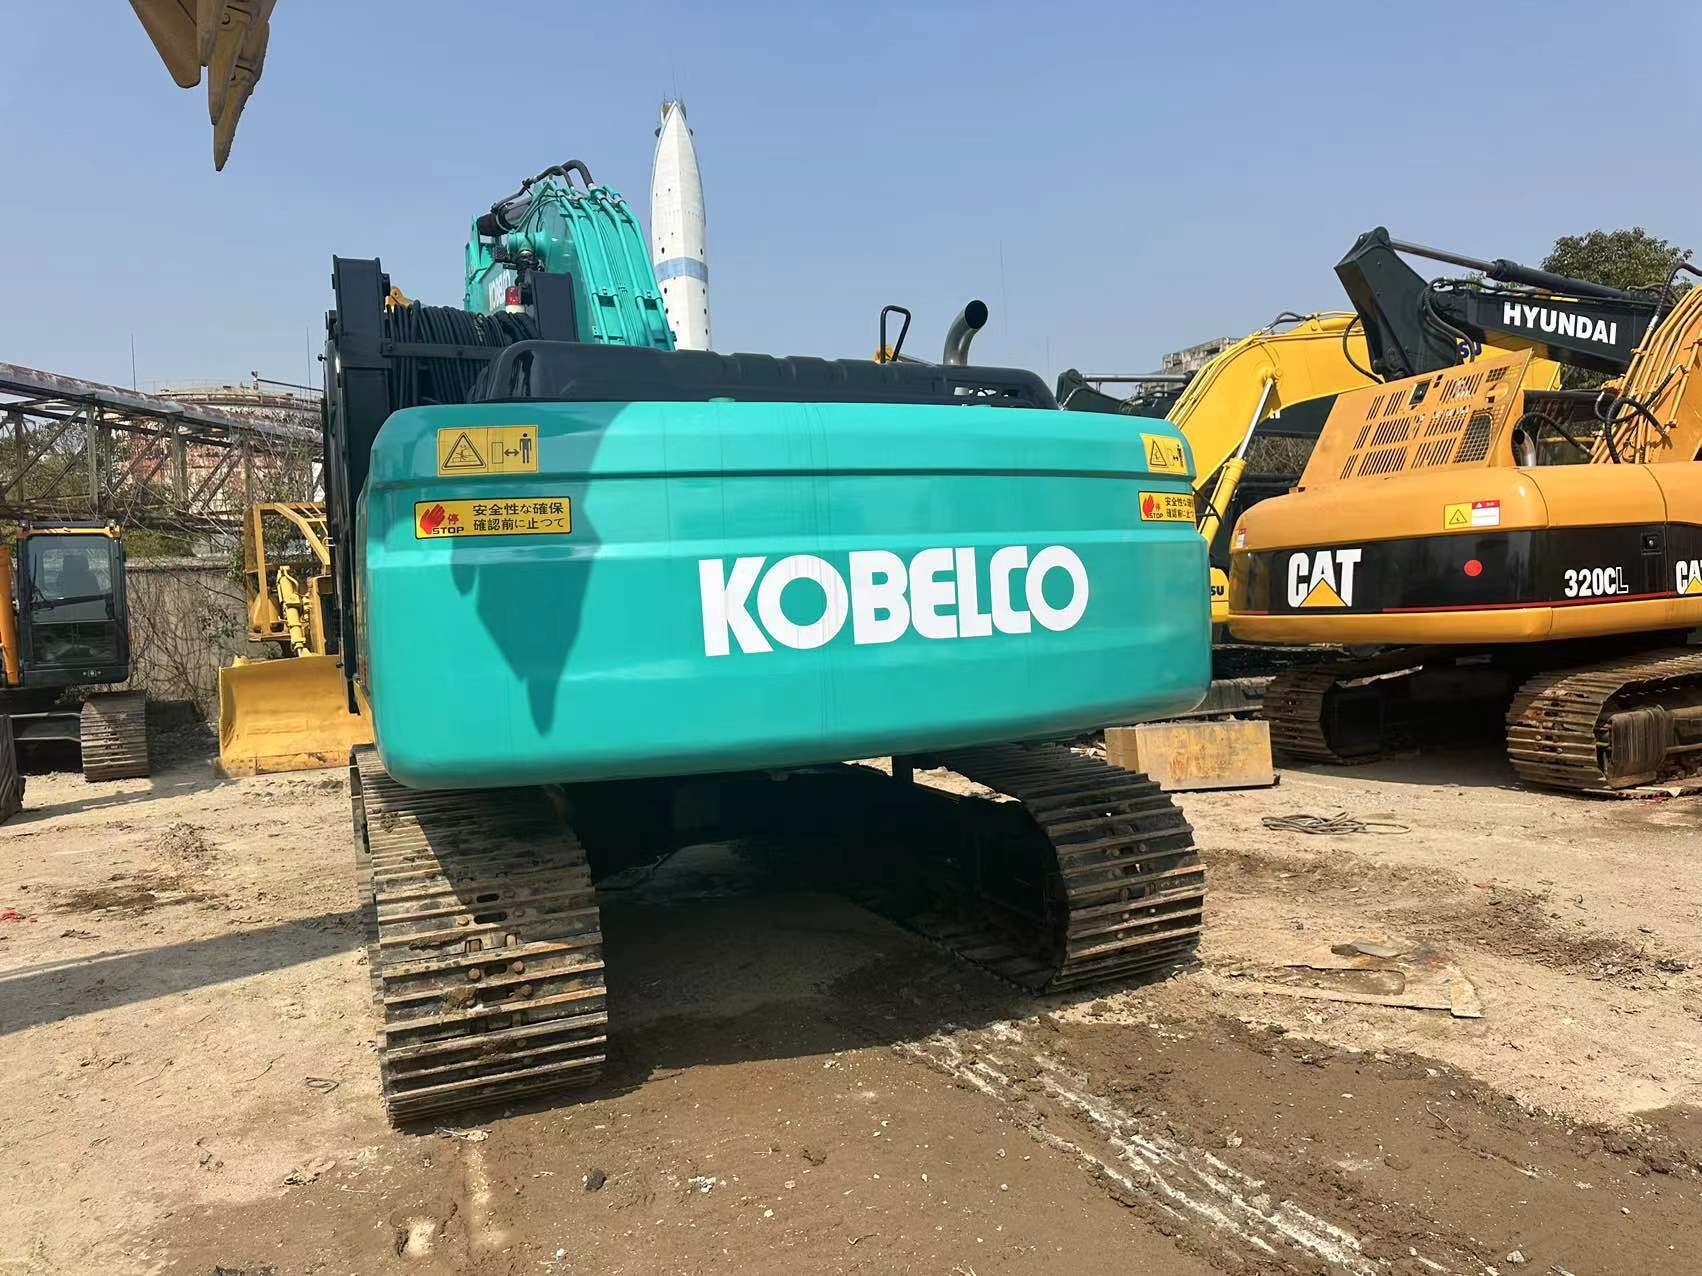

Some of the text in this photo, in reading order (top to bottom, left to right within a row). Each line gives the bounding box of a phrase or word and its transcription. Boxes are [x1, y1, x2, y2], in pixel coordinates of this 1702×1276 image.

[1503, 301, 1618, 346] HYUNDAI
[472, 501, 564, 517] 安全性な確保
[432, 526, 465, 535] STOP
[1288, 548, 1362, 608] CAT
[1564, 566, 1629, 598] 320CL
[698, 544, 1090, 658] KOBELCO
